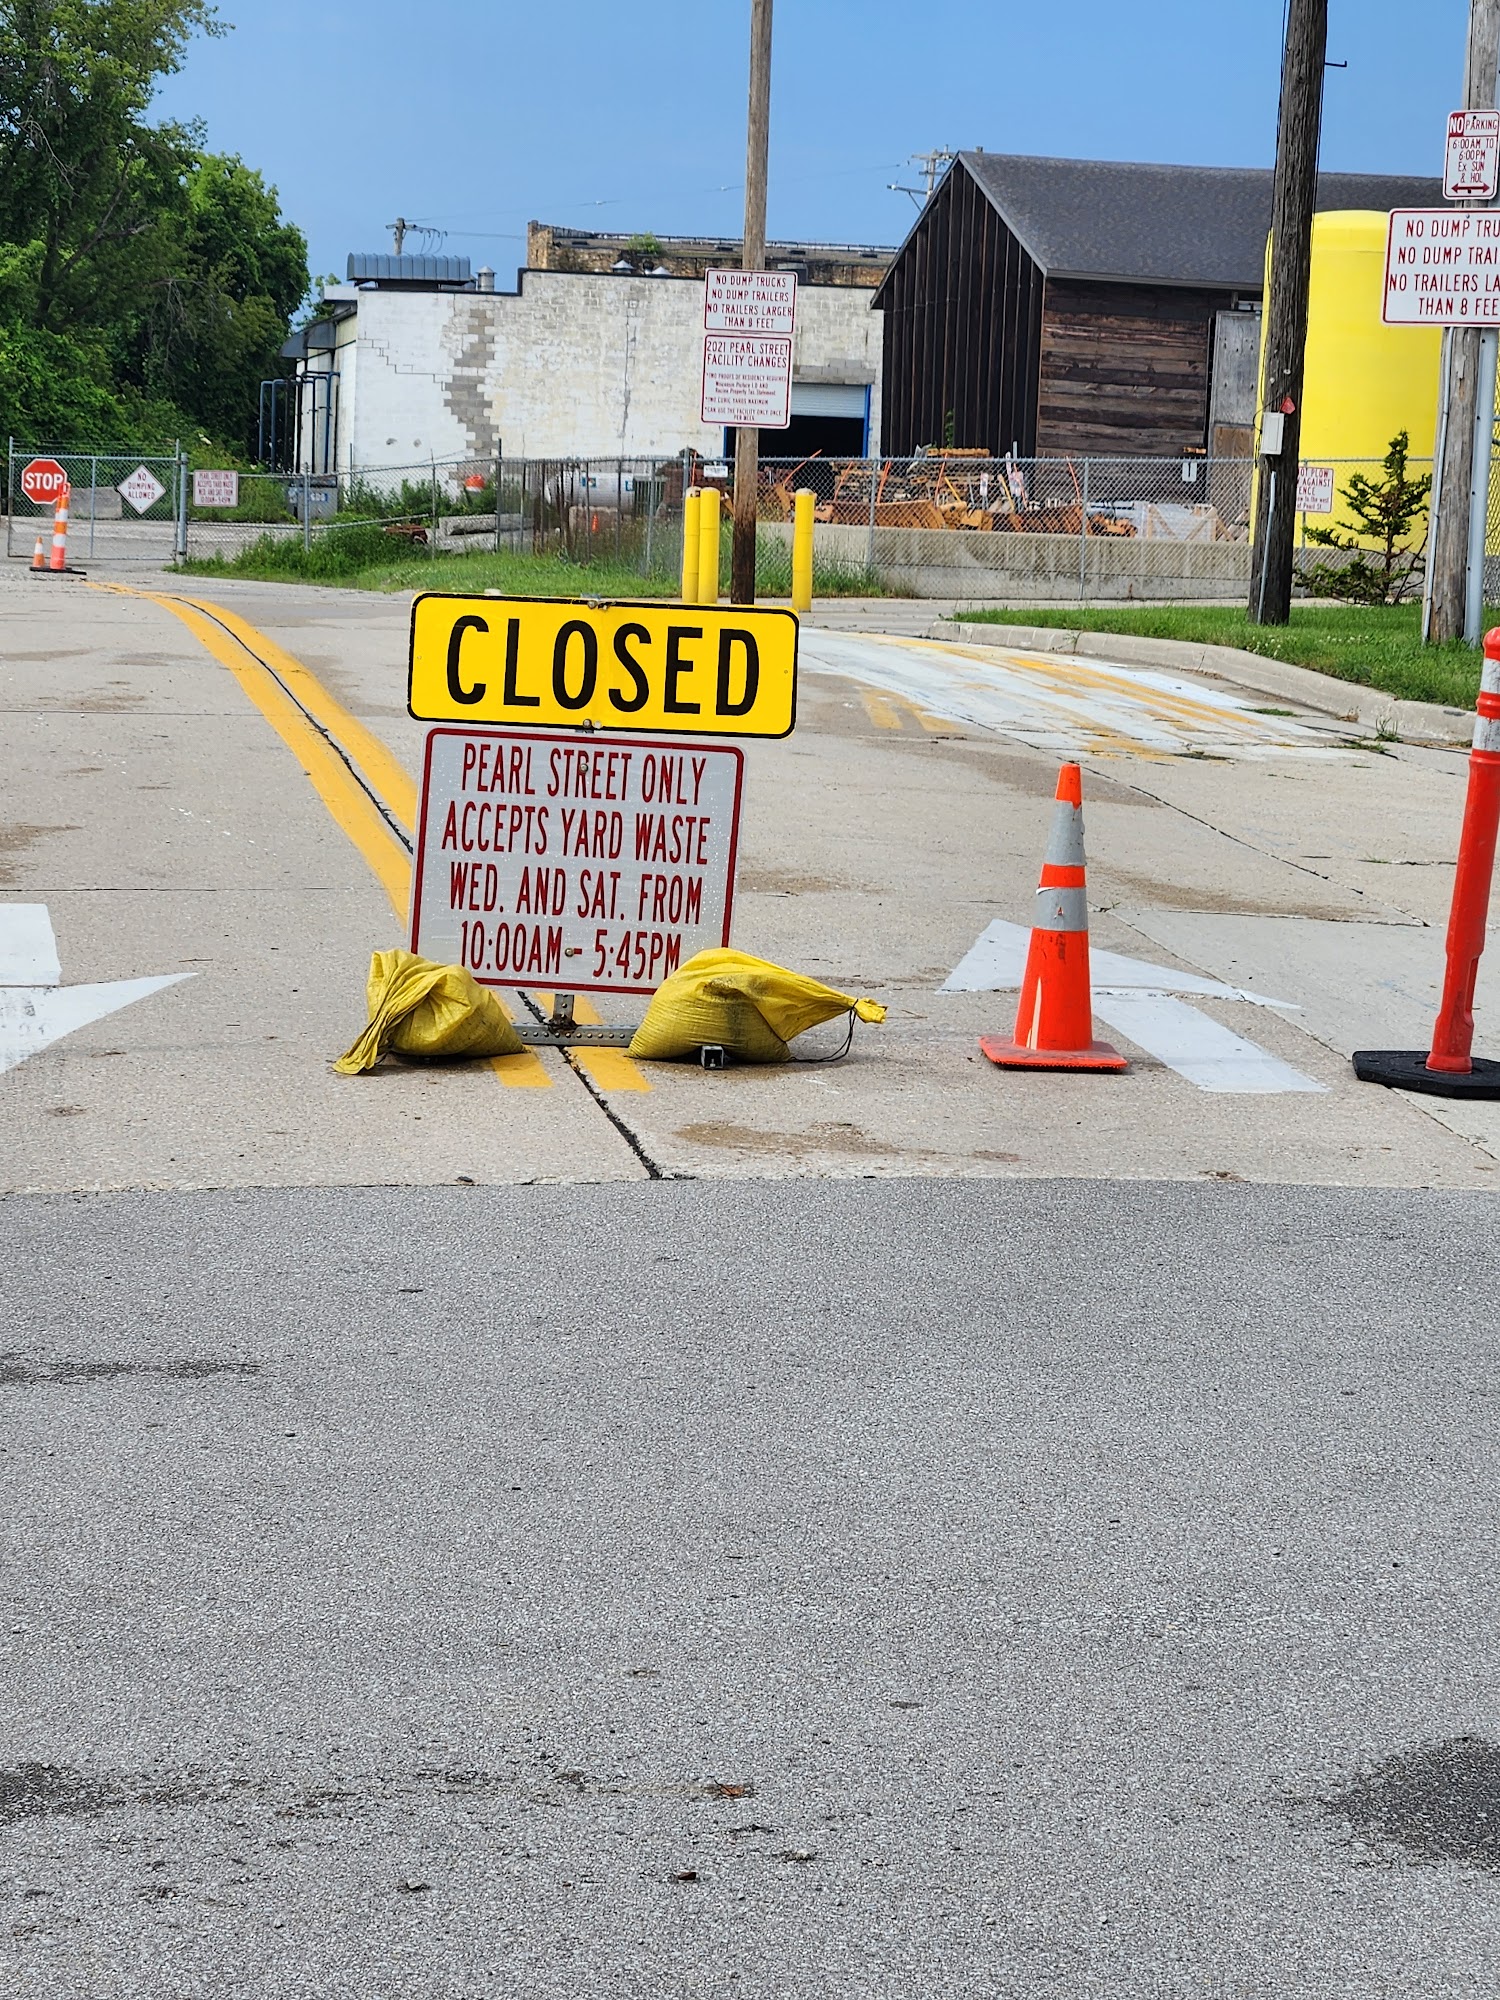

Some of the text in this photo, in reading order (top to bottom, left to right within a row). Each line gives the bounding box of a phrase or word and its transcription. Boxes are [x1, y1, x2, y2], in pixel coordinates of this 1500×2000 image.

[1450, 117, 1497, 133] NO PARKING
[1453, 138, 1494, 149] 6:00AM TO
[1459, 150, 1485, 160] 6:00PM
[1458, 161, 1485, 172] Ex SUN
[1461, 173, 1465, 183] &
[1406, 220, 1500, 237] NO DUMP TRU
[1398, 247, 1498, 264] NO DUMP TRAI
[716, 275, 786, 288] NO DUMP TRUCKS
[1389, 274, 1500, 292] NO TRAILERS LA
[712, 289, 789, 302] NO DUMP TRAILERS
[707, 303, 792, 317] NO TRAILERS LARGER
[1419, 298, 1499, 316] THAN 8 FEE
[724, 316, 745, 327] THAN
[756, 318, 774, 328] FEET
[707, 341, 788, 356] 2021 PEARL STREET
[707, 354, 787, 368] FACILITY CHANGES
[1311, 468, 1328, 478] PLOW
[25, 472, 64, 490] STOP
[128, 482, 155, 490] DUMPING
[1303, 478, 1330, 487] AGAINST
[128, 490, 155, 499] ALLOWED
[1299, 487, 1315, 495] ENCE
[447, 614, 760, 716] CLOSED
[461, 743, 706, 805] PEARL STREET ONLY
[441, 800, 710, 865] ACCEPTS YARD WASTE
[450, 861, 702, 925] WED. AND SAT. FROM
[461, 921, 562, 975] 10:00AM
[593, 929, 682, 980] 5:45PM
